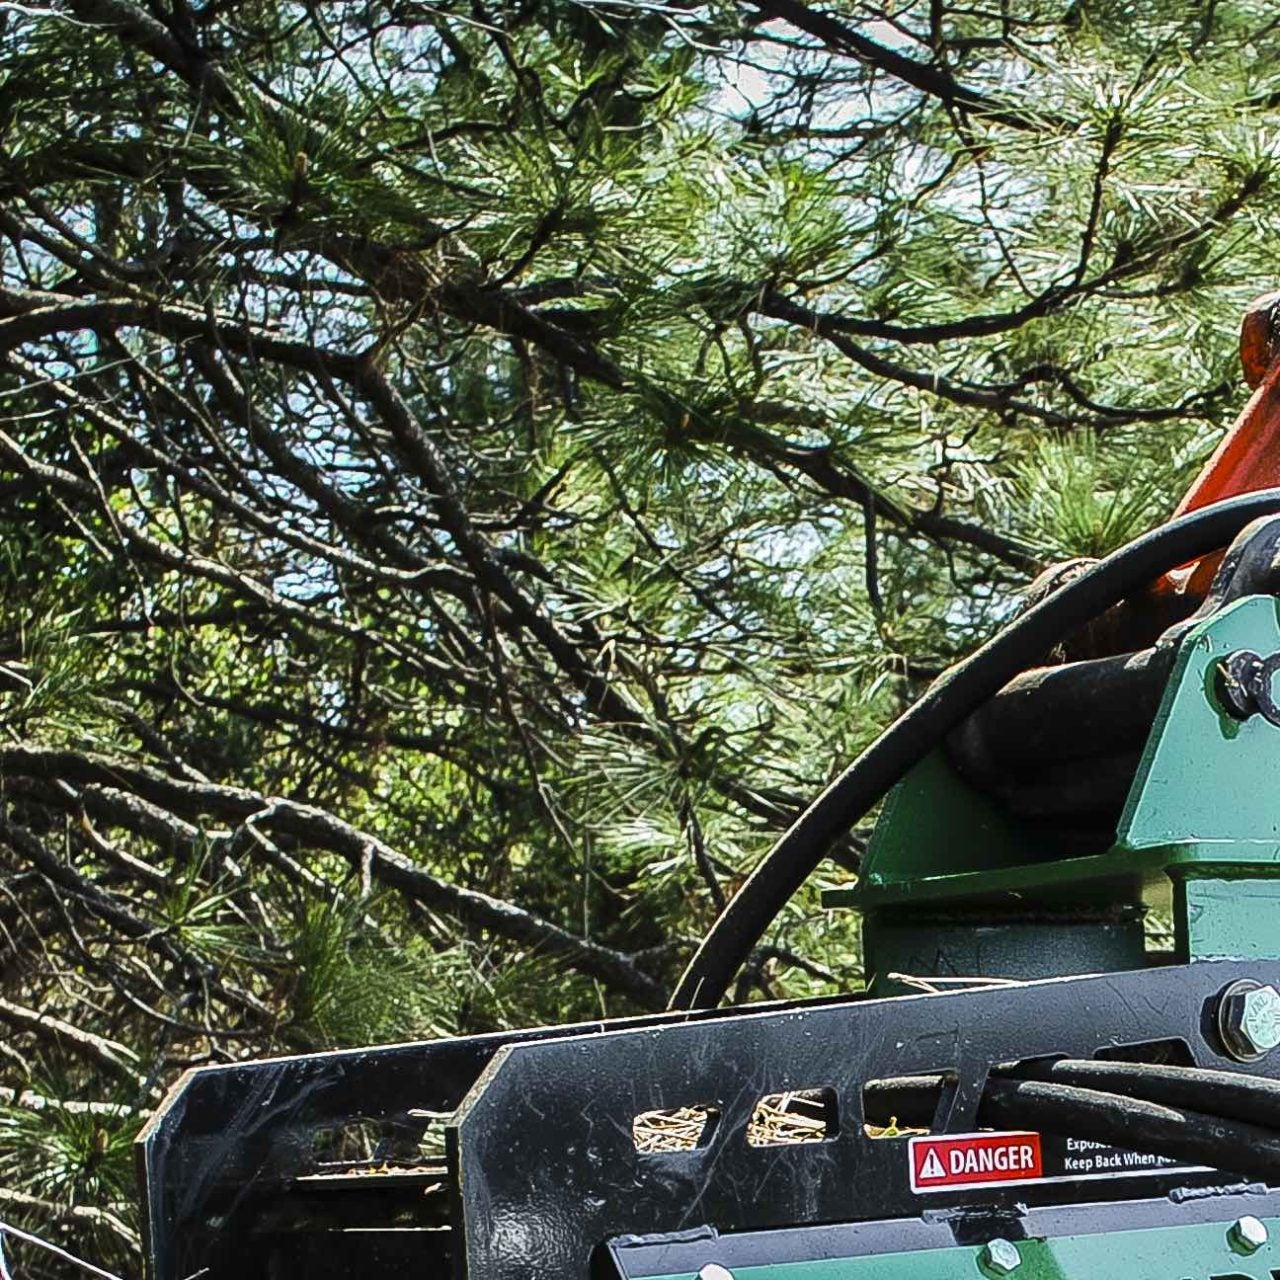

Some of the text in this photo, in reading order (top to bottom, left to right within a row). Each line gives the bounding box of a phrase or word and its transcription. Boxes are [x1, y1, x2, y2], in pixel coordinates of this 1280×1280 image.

[949, 1145, 1034, 1175] DANGER
[1064, 1157, 1093, 1171] Keep
[1095, 1154, 1122, 1168] Back
[1123, 1151, 1156, 1166] When
